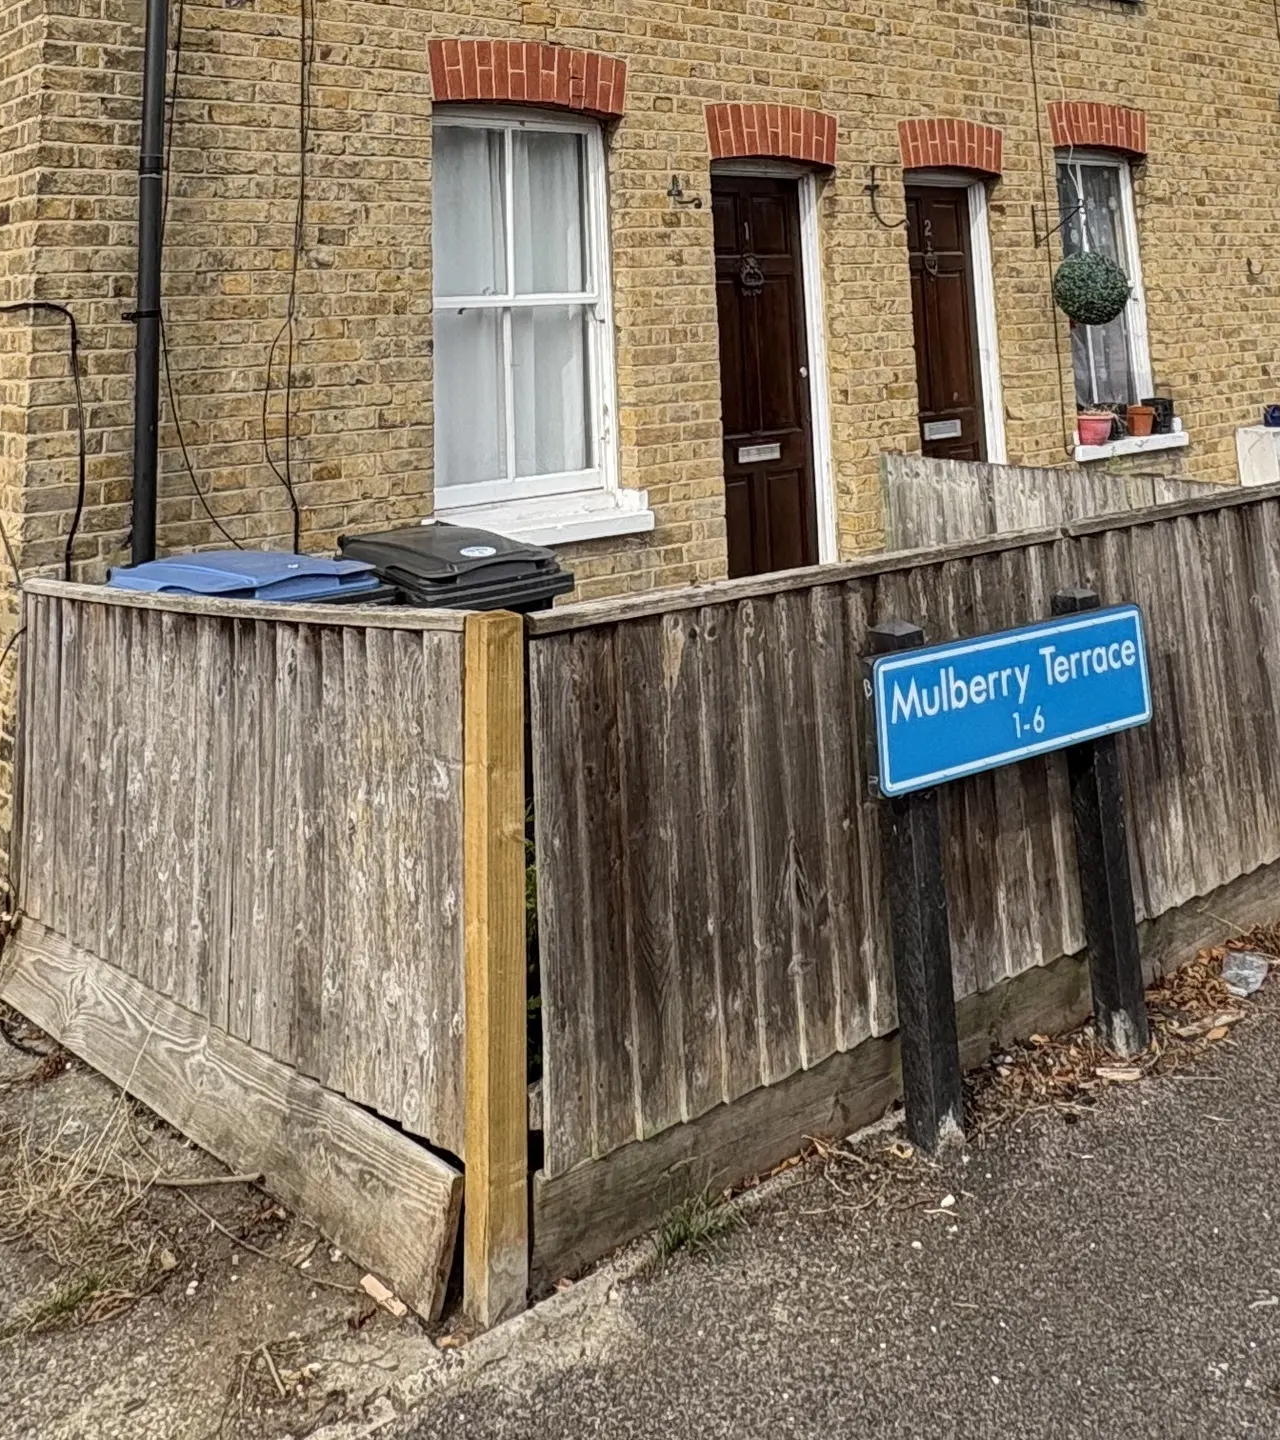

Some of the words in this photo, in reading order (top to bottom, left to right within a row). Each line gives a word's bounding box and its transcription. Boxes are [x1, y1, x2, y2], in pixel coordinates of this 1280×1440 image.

[924, 219, 932, 236] 2
[890, 664, 1031, 725] Mulberry
[1038, 638, 1136, 686] Terrace
[1011, 705, 1046, 738] 1-6
